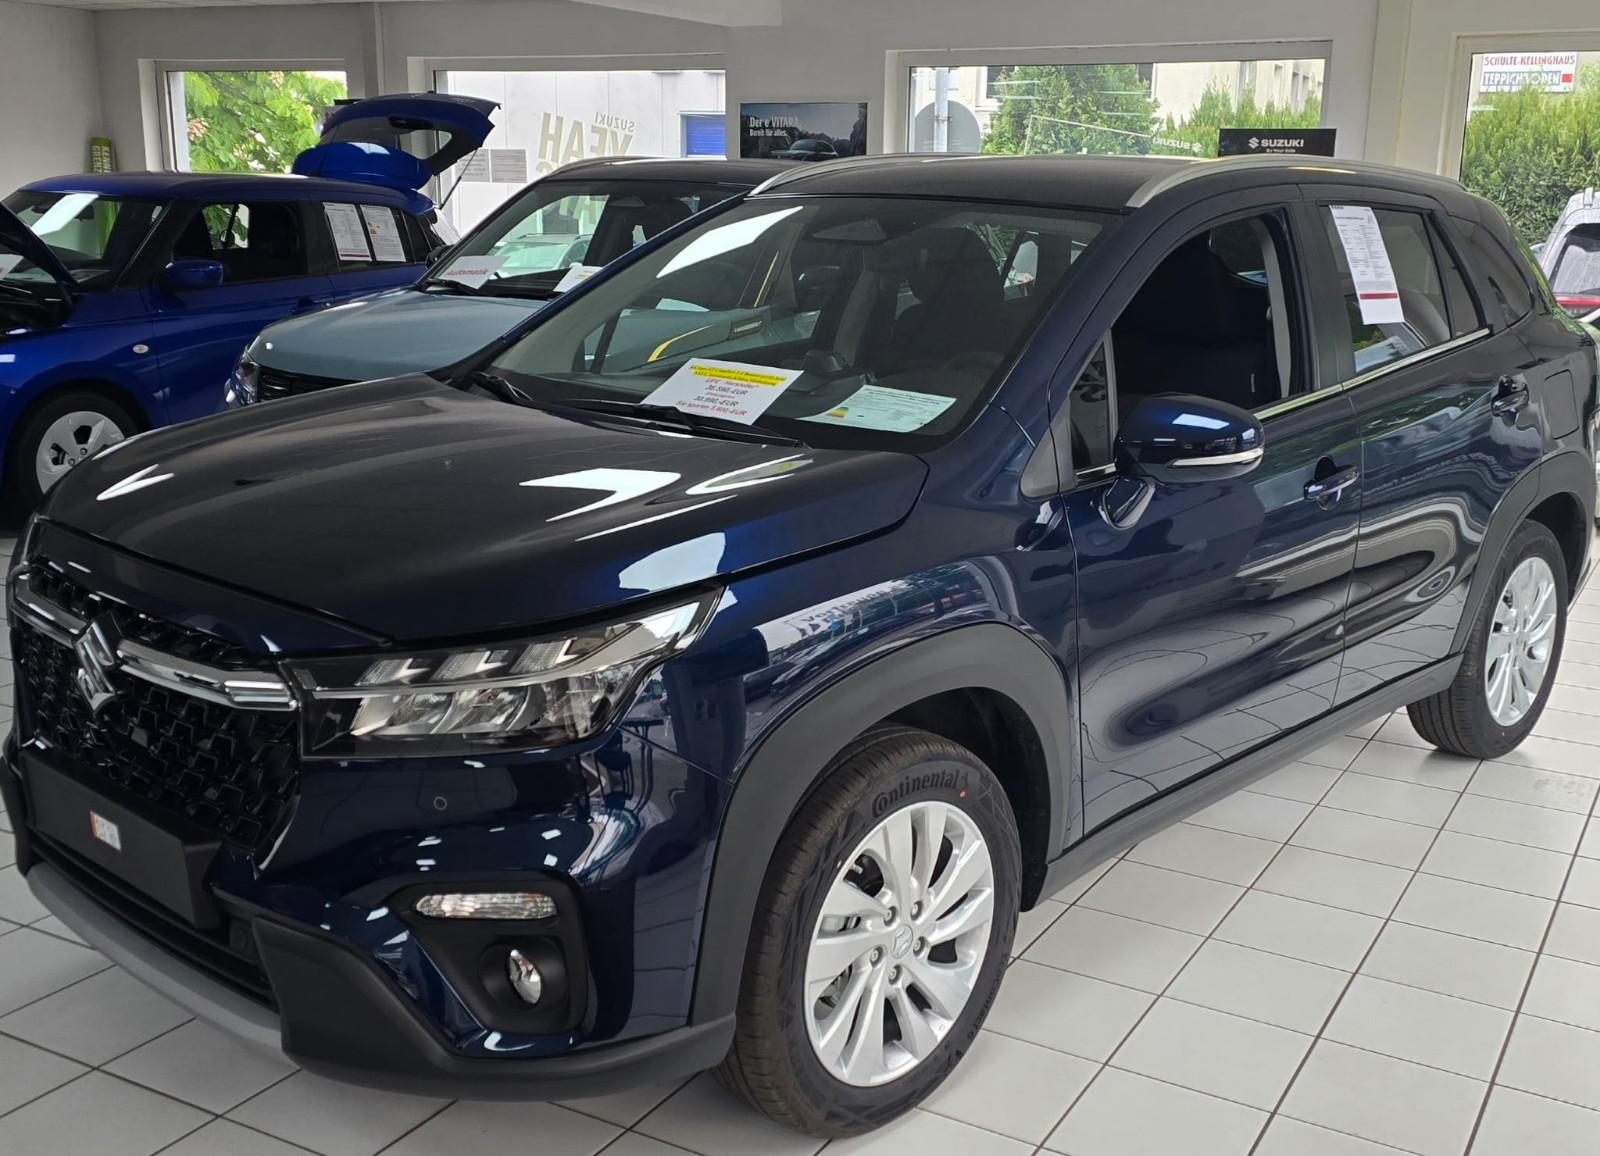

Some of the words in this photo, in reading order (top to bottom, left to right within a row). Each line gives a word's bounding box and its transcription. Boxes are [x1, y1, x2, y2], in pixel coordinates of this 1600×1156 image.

[1484, 55, 1575, 66] SCHULTE-KELLINGHAUS
[749, 117, 762, 128] Der
[764, 119, 770, 128] e
[771, 116, 800, 128] VITARA
[1260, 138, 1305, 148] SUZUKI
[872, 769, 959, 818] Continental
